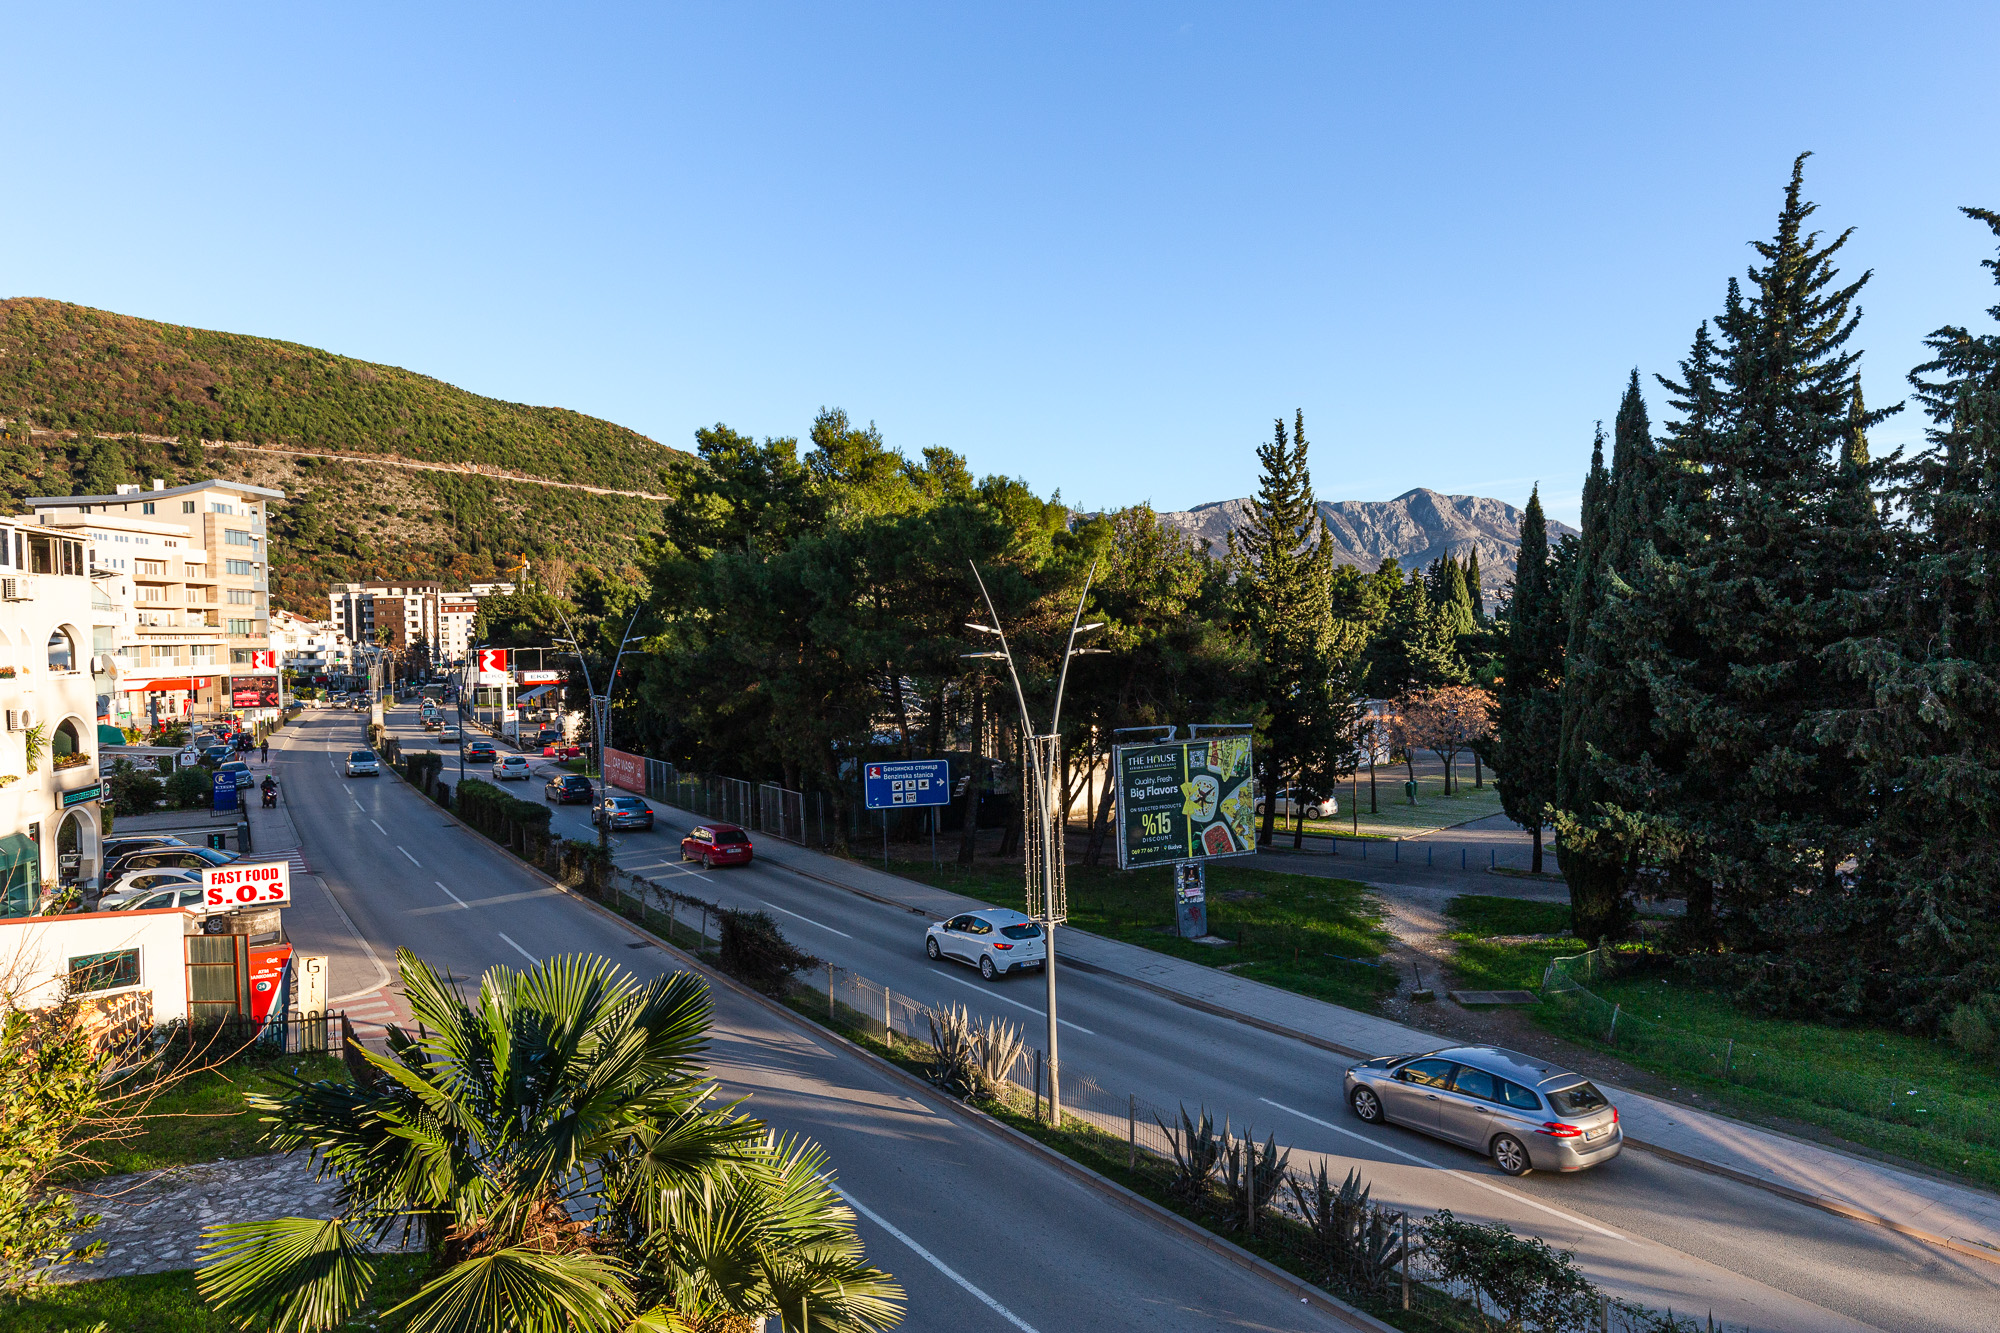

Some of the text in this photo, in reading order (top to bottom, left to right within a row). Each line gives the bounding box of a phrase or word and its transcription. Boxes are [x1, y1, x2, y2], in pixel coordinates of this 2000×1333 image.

[621, 759, 634, 774] WASH
[1128, 753, 1176, 766] THE HOUSE
[1157, 775, 1173, 783] Fresh
[1130, 785, 1178, 799] Big Flavors
[1142, 812, 1171, 836] %15
[1142, 835, 1172, 843] DISCOUNT
[211, 868, 279, 885] FAST FOOD
[207, 882, 284, 905] S.O.S
